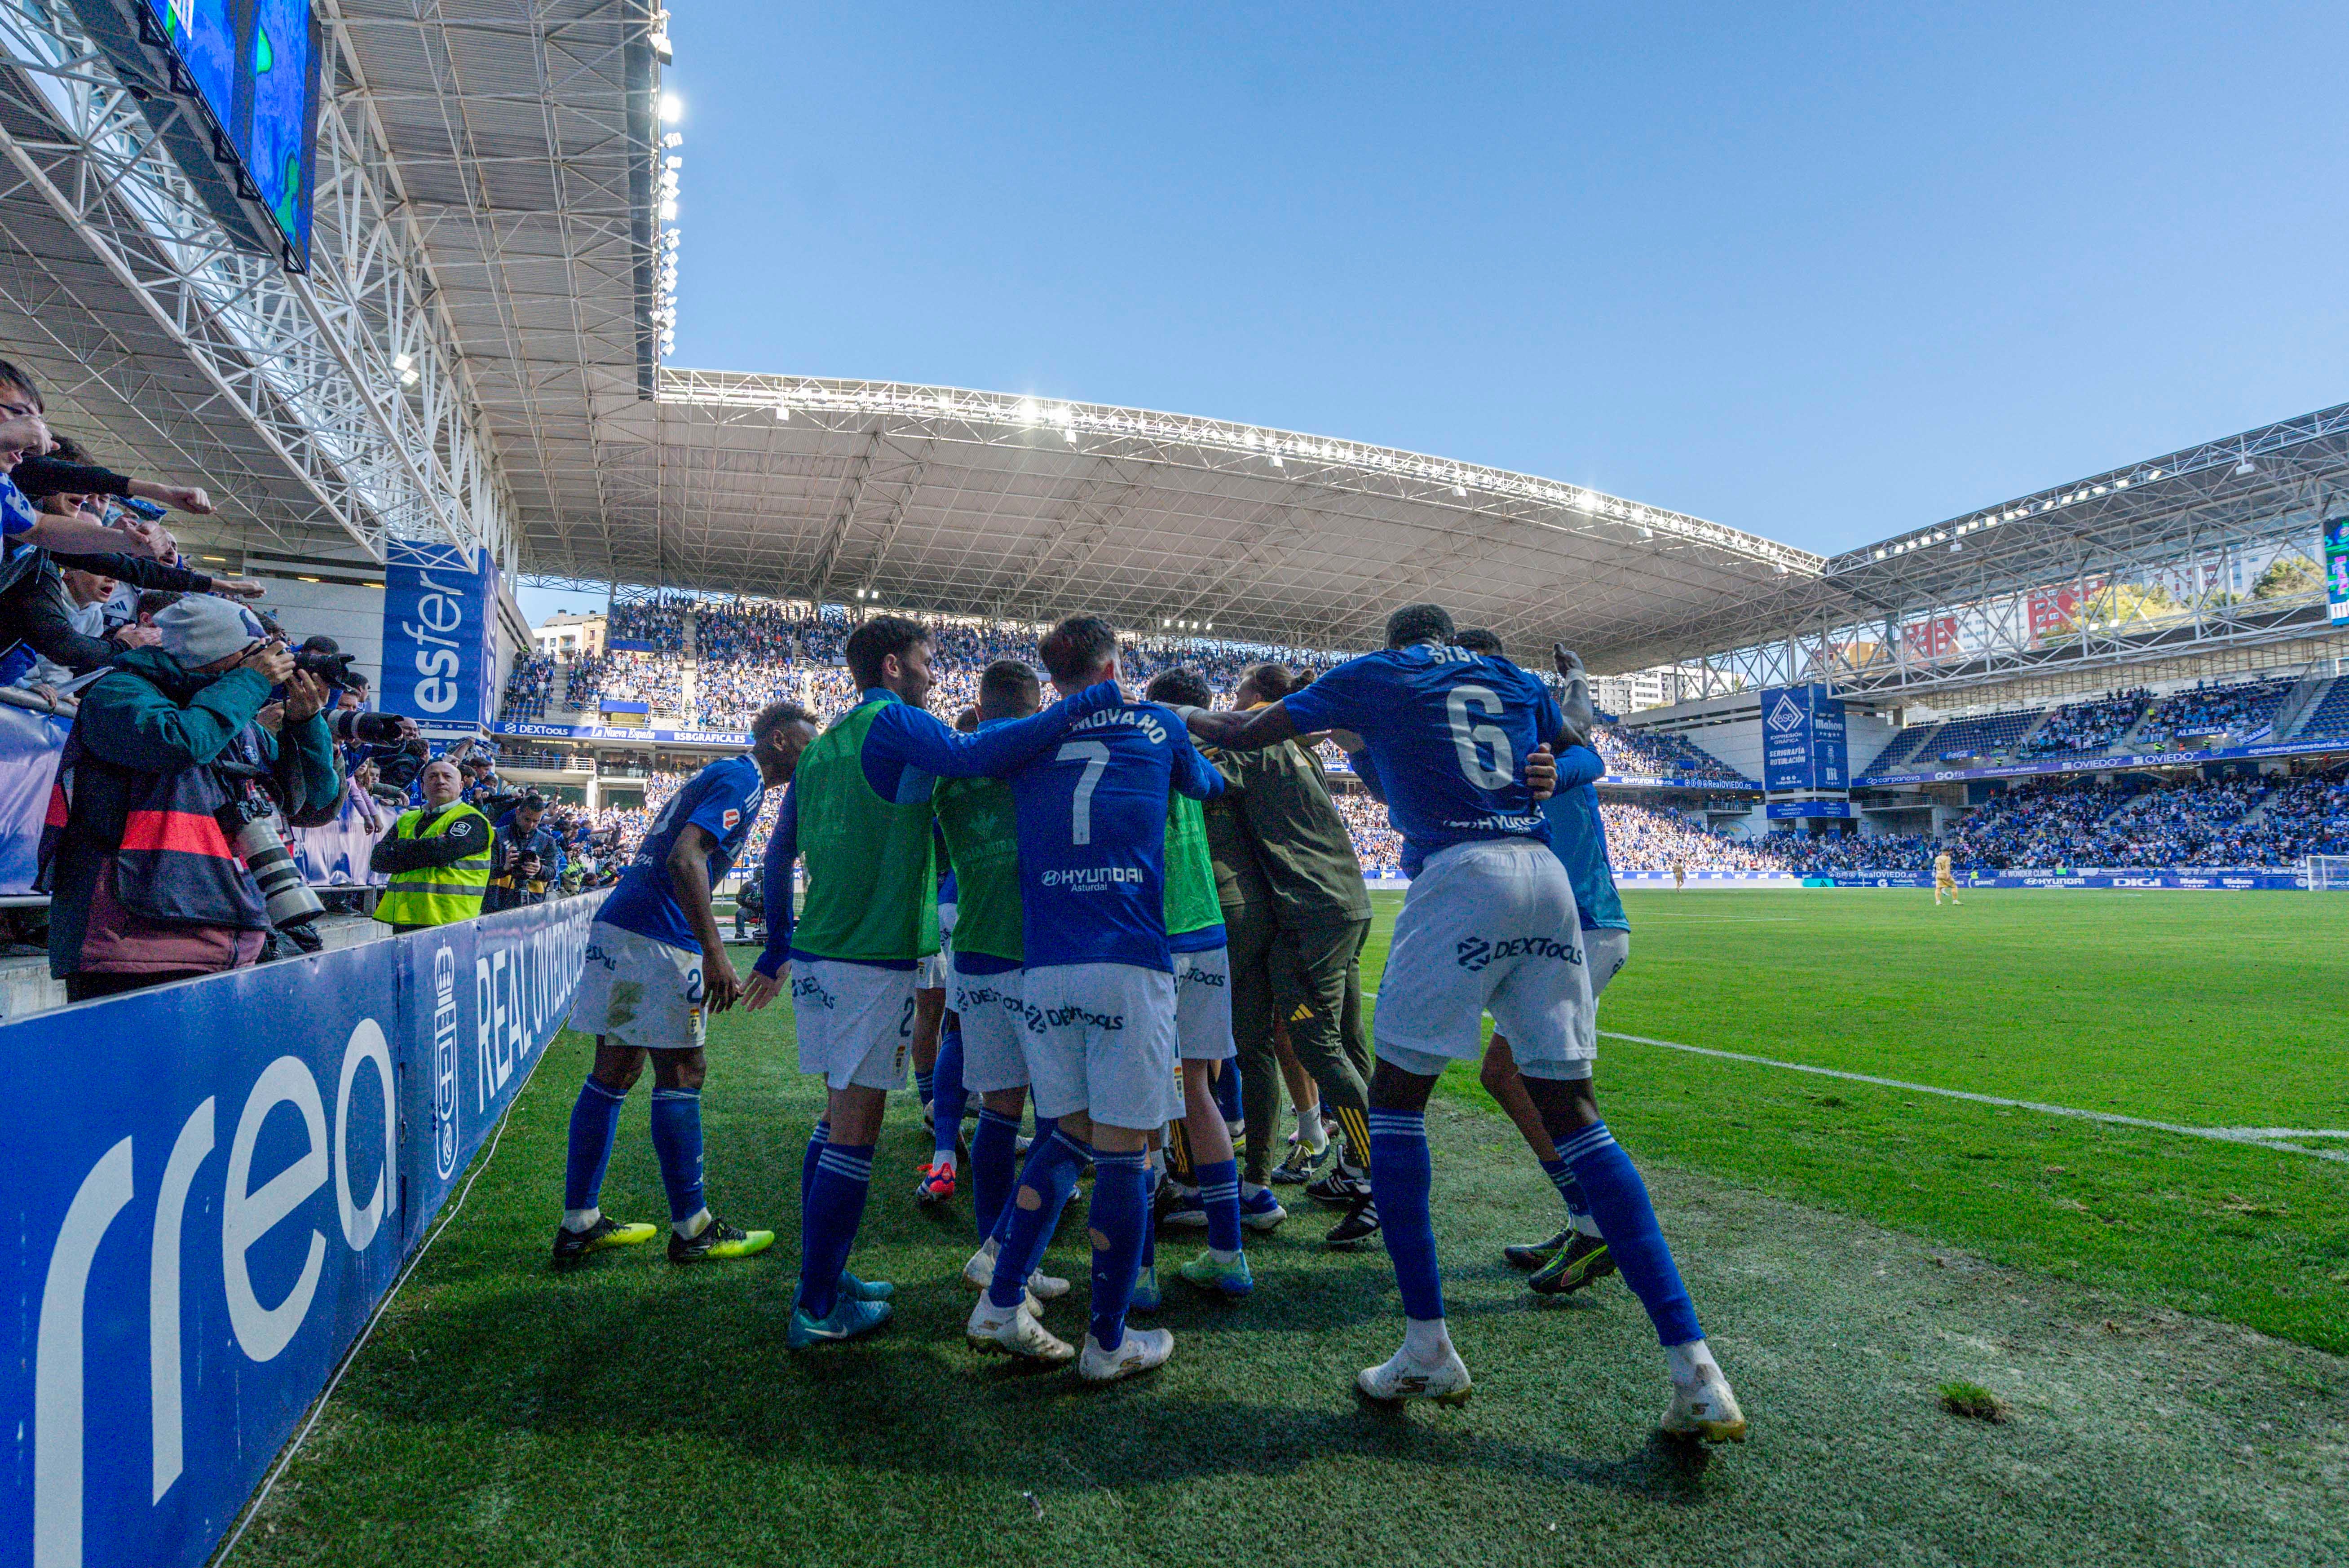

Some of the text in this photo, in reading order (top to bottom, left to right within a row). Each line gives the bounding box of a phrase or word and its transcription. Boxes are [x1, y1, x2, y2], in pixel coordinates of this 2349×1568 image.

[403, 570, 464, 713] esfer
[1815, 719, 1843, 731] Mahou
[674, 732, 746, 743] BSBGRAFICA.ES
[1447, 685, 1514, 790] 6
[1770, 746, 1805, 757] SERIGRAFÍA
[1770, 755, 1806, 765] ROTULACIÓN
[2146, 752, 2193, 763] OVIEDO
[2073, 759, 2117, 769] OVIEDO
[1709, 780, 1751, 789] RealOVIEDO.es
[1878, 775, 1920, 783] carpanova
[1055, 740, 1110, 844] 7
[1061, 867, 1143, 884] HYUNDAI
[1071, 883, 1108, 892] Asturdai
[2113, 878, 2161, 886] DIGI
[476, 940, 532, 1114] REAL
[532, 918, 572, 1034] OVIEDO
